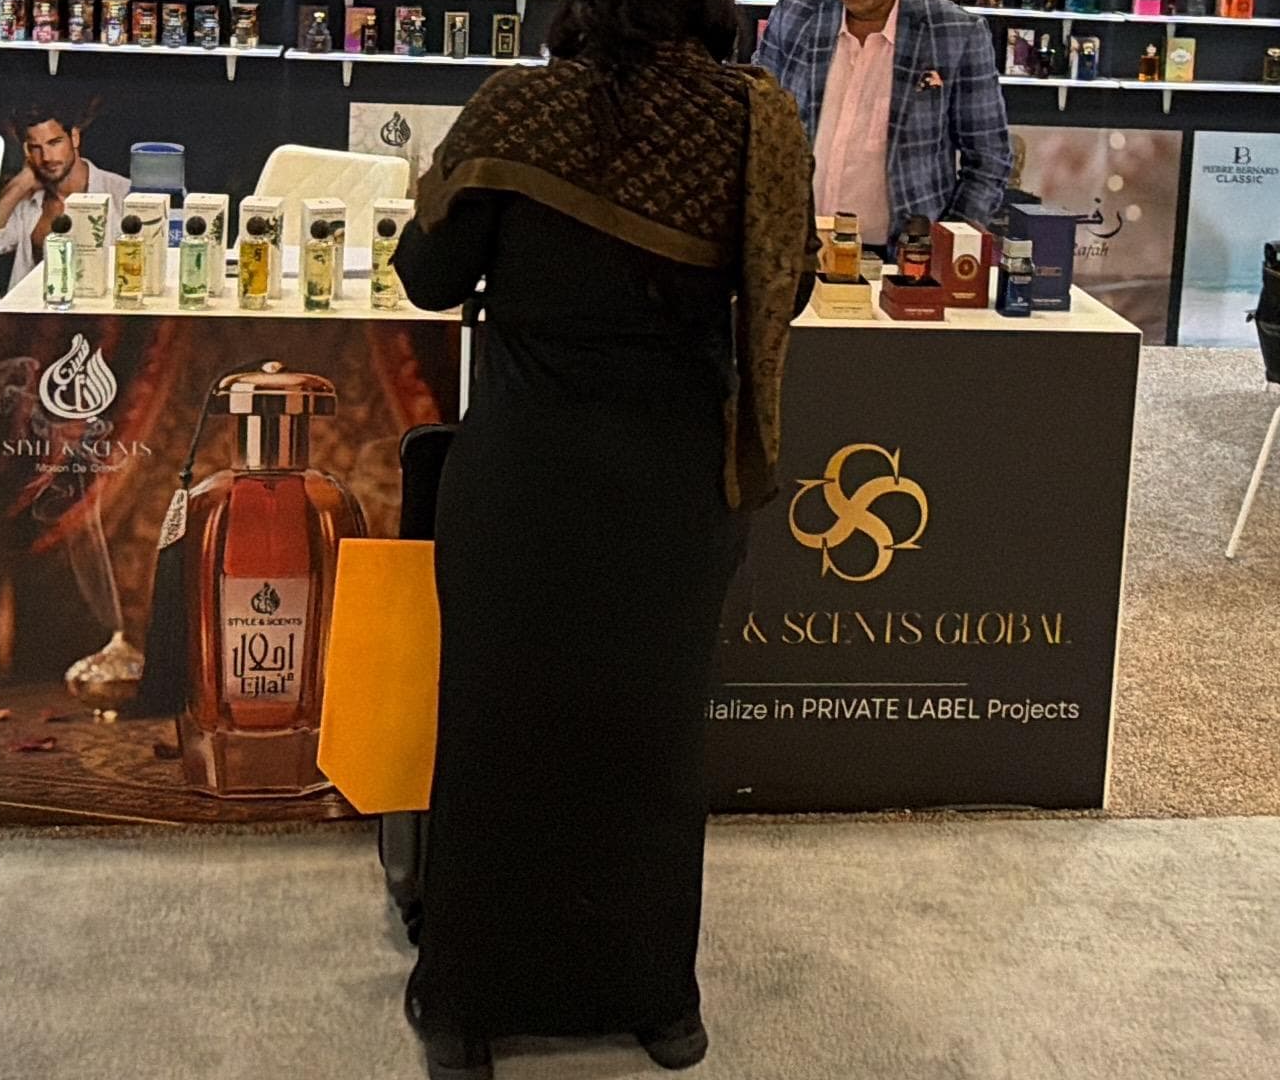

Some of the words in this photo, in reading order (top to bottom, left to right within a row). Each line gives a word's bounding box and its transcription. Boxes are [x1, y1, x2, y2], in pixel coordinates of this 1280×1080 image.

[1215, 174, 1264, 184] CLASSIC
[227, 617, 257, 626] STYLE
[266, 617, 303, 626] SCENTS
[742, 610, 768, 644] &
[781, 609, 923, 645] SCENTS
[934, 609, 1072, 645] GLOBAL
[706, 698, 767, 720] ialize
[774, 699, 795, 720] in
[801, 697, 900, 720] PRIVATE
[907, 697, 981, 720] LABEL
[986, 698, 1080, 723] Projects
